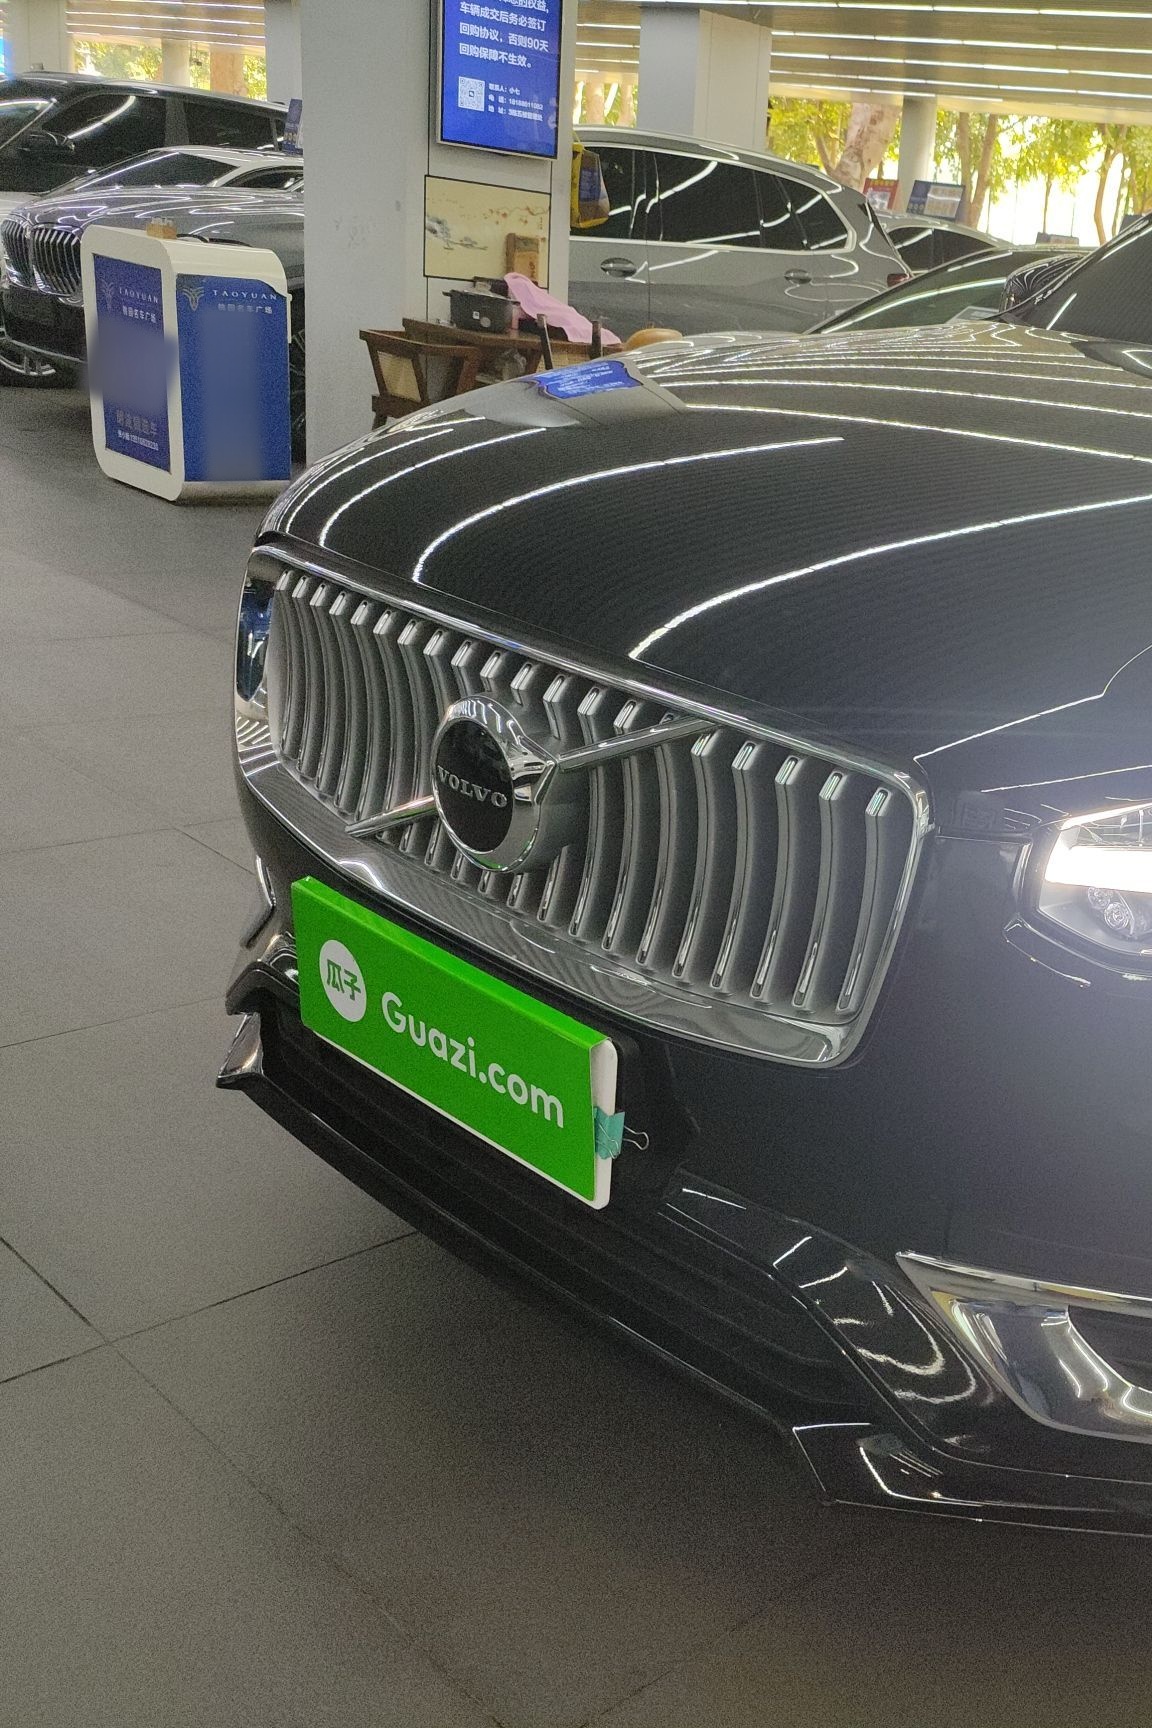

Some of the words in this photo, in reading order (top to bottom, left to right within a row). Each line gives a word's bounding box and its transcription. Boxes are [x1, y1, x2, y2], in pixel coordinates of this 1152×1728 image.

[460, 1, 547, 32] 车辆成交后务必签订
[459, 42, 532, 69] 回购保障不生效。
[119, 287, 158, 304] TAOYUAN
[212, 289, 277, 301] TAOYUAN
[436, 764, 508, 808] VOLVO
[325, 957, 362, 1001] 瓜子
[381, 991, 565, 1129] Guazi.com
